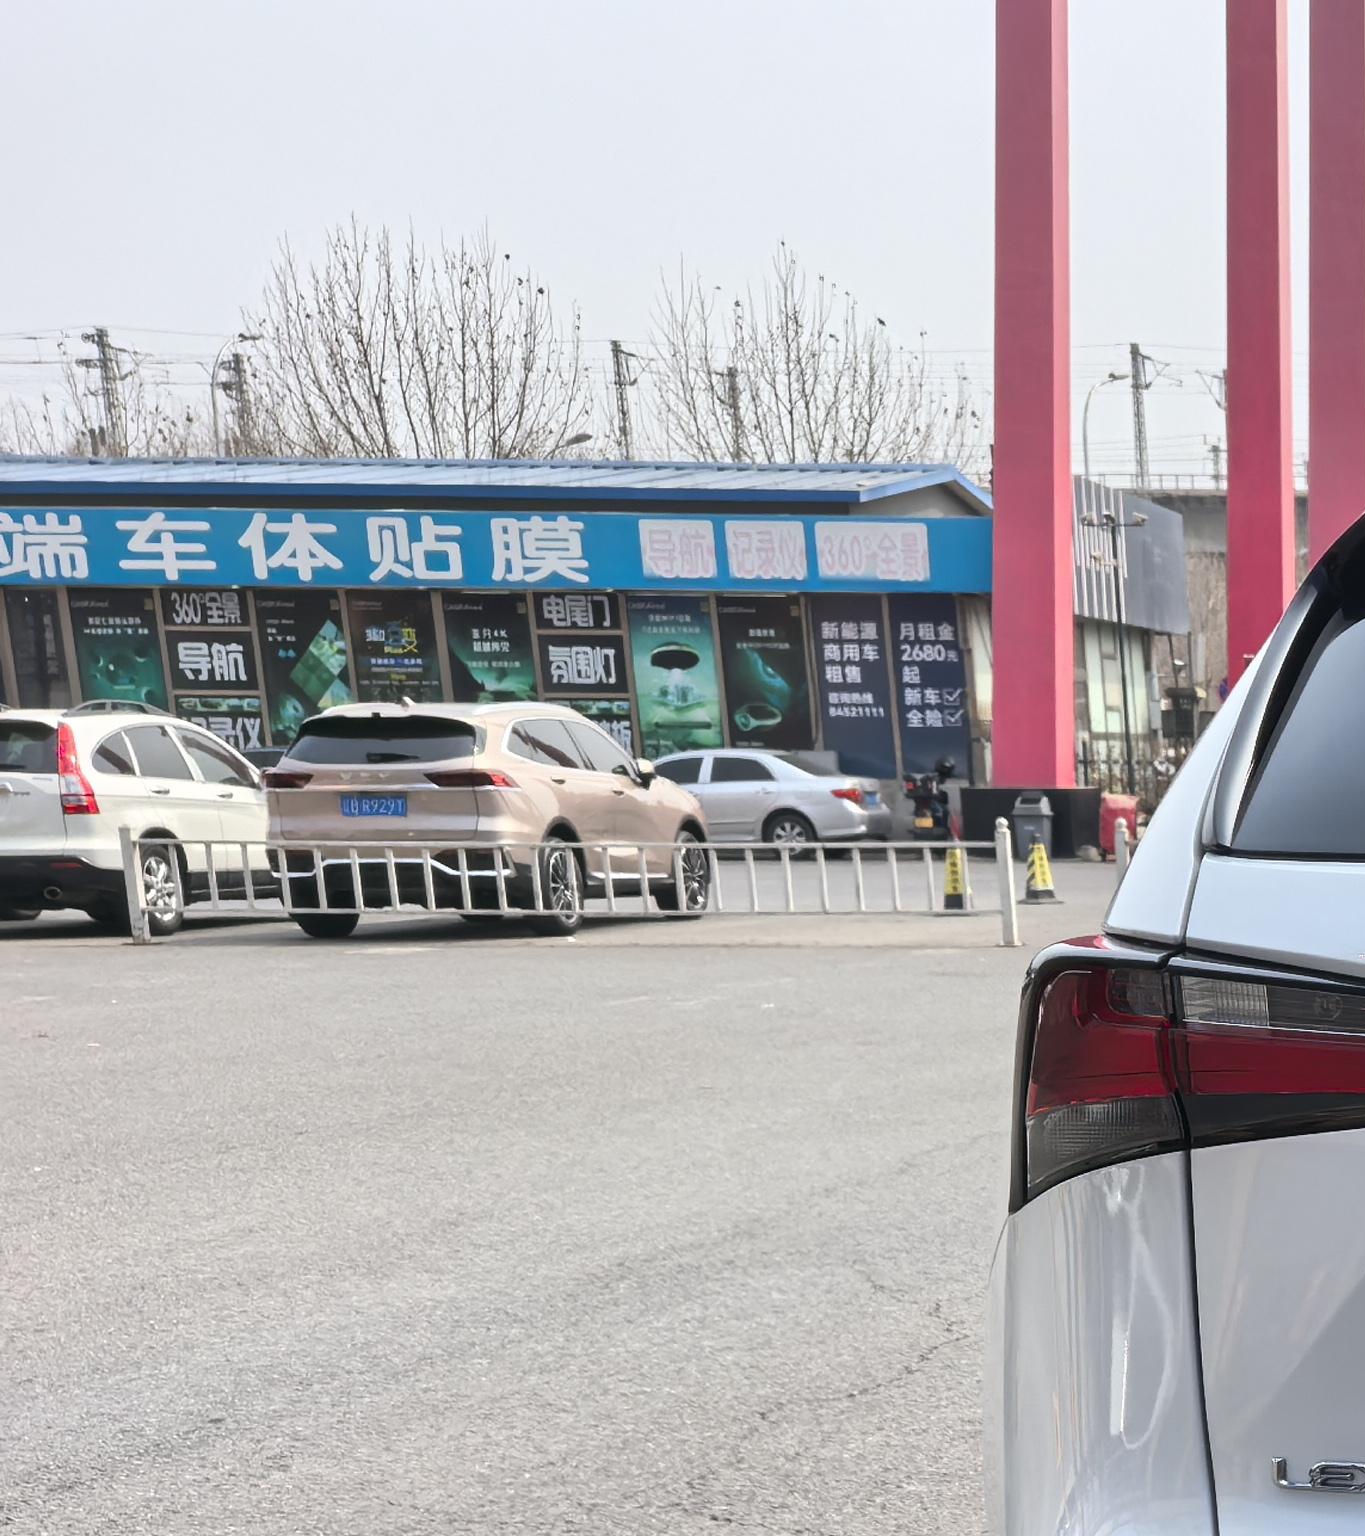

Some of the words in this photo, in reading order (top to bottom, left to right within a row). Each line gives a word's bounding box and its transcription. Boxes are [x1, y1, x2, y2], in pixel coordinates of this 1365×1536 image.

[0, 512, 589, 583] 端车体贴膜
[648, 528, 715, 578] 导航
[171, 591, 242, 624] 360°全景
[542, 595, 611, 627] 电尾门
[821, 622, 878, 640] 新能源
[900, 622, 955, 640] 月租金
[177, 641, 247, 681] 导航
[823, 643, 880, 662] 商用车
[901, 644, 959, 662] 2680元
[548, 645, 617, 685] 氛围灯
[825, 665, 862, 684] 租售
[902, 665, 921, 684] 起
[904, 687, 941, 706] 新车
[906, 709, 943, 727] 全险
[191, 716, 261, 750] 录仪
